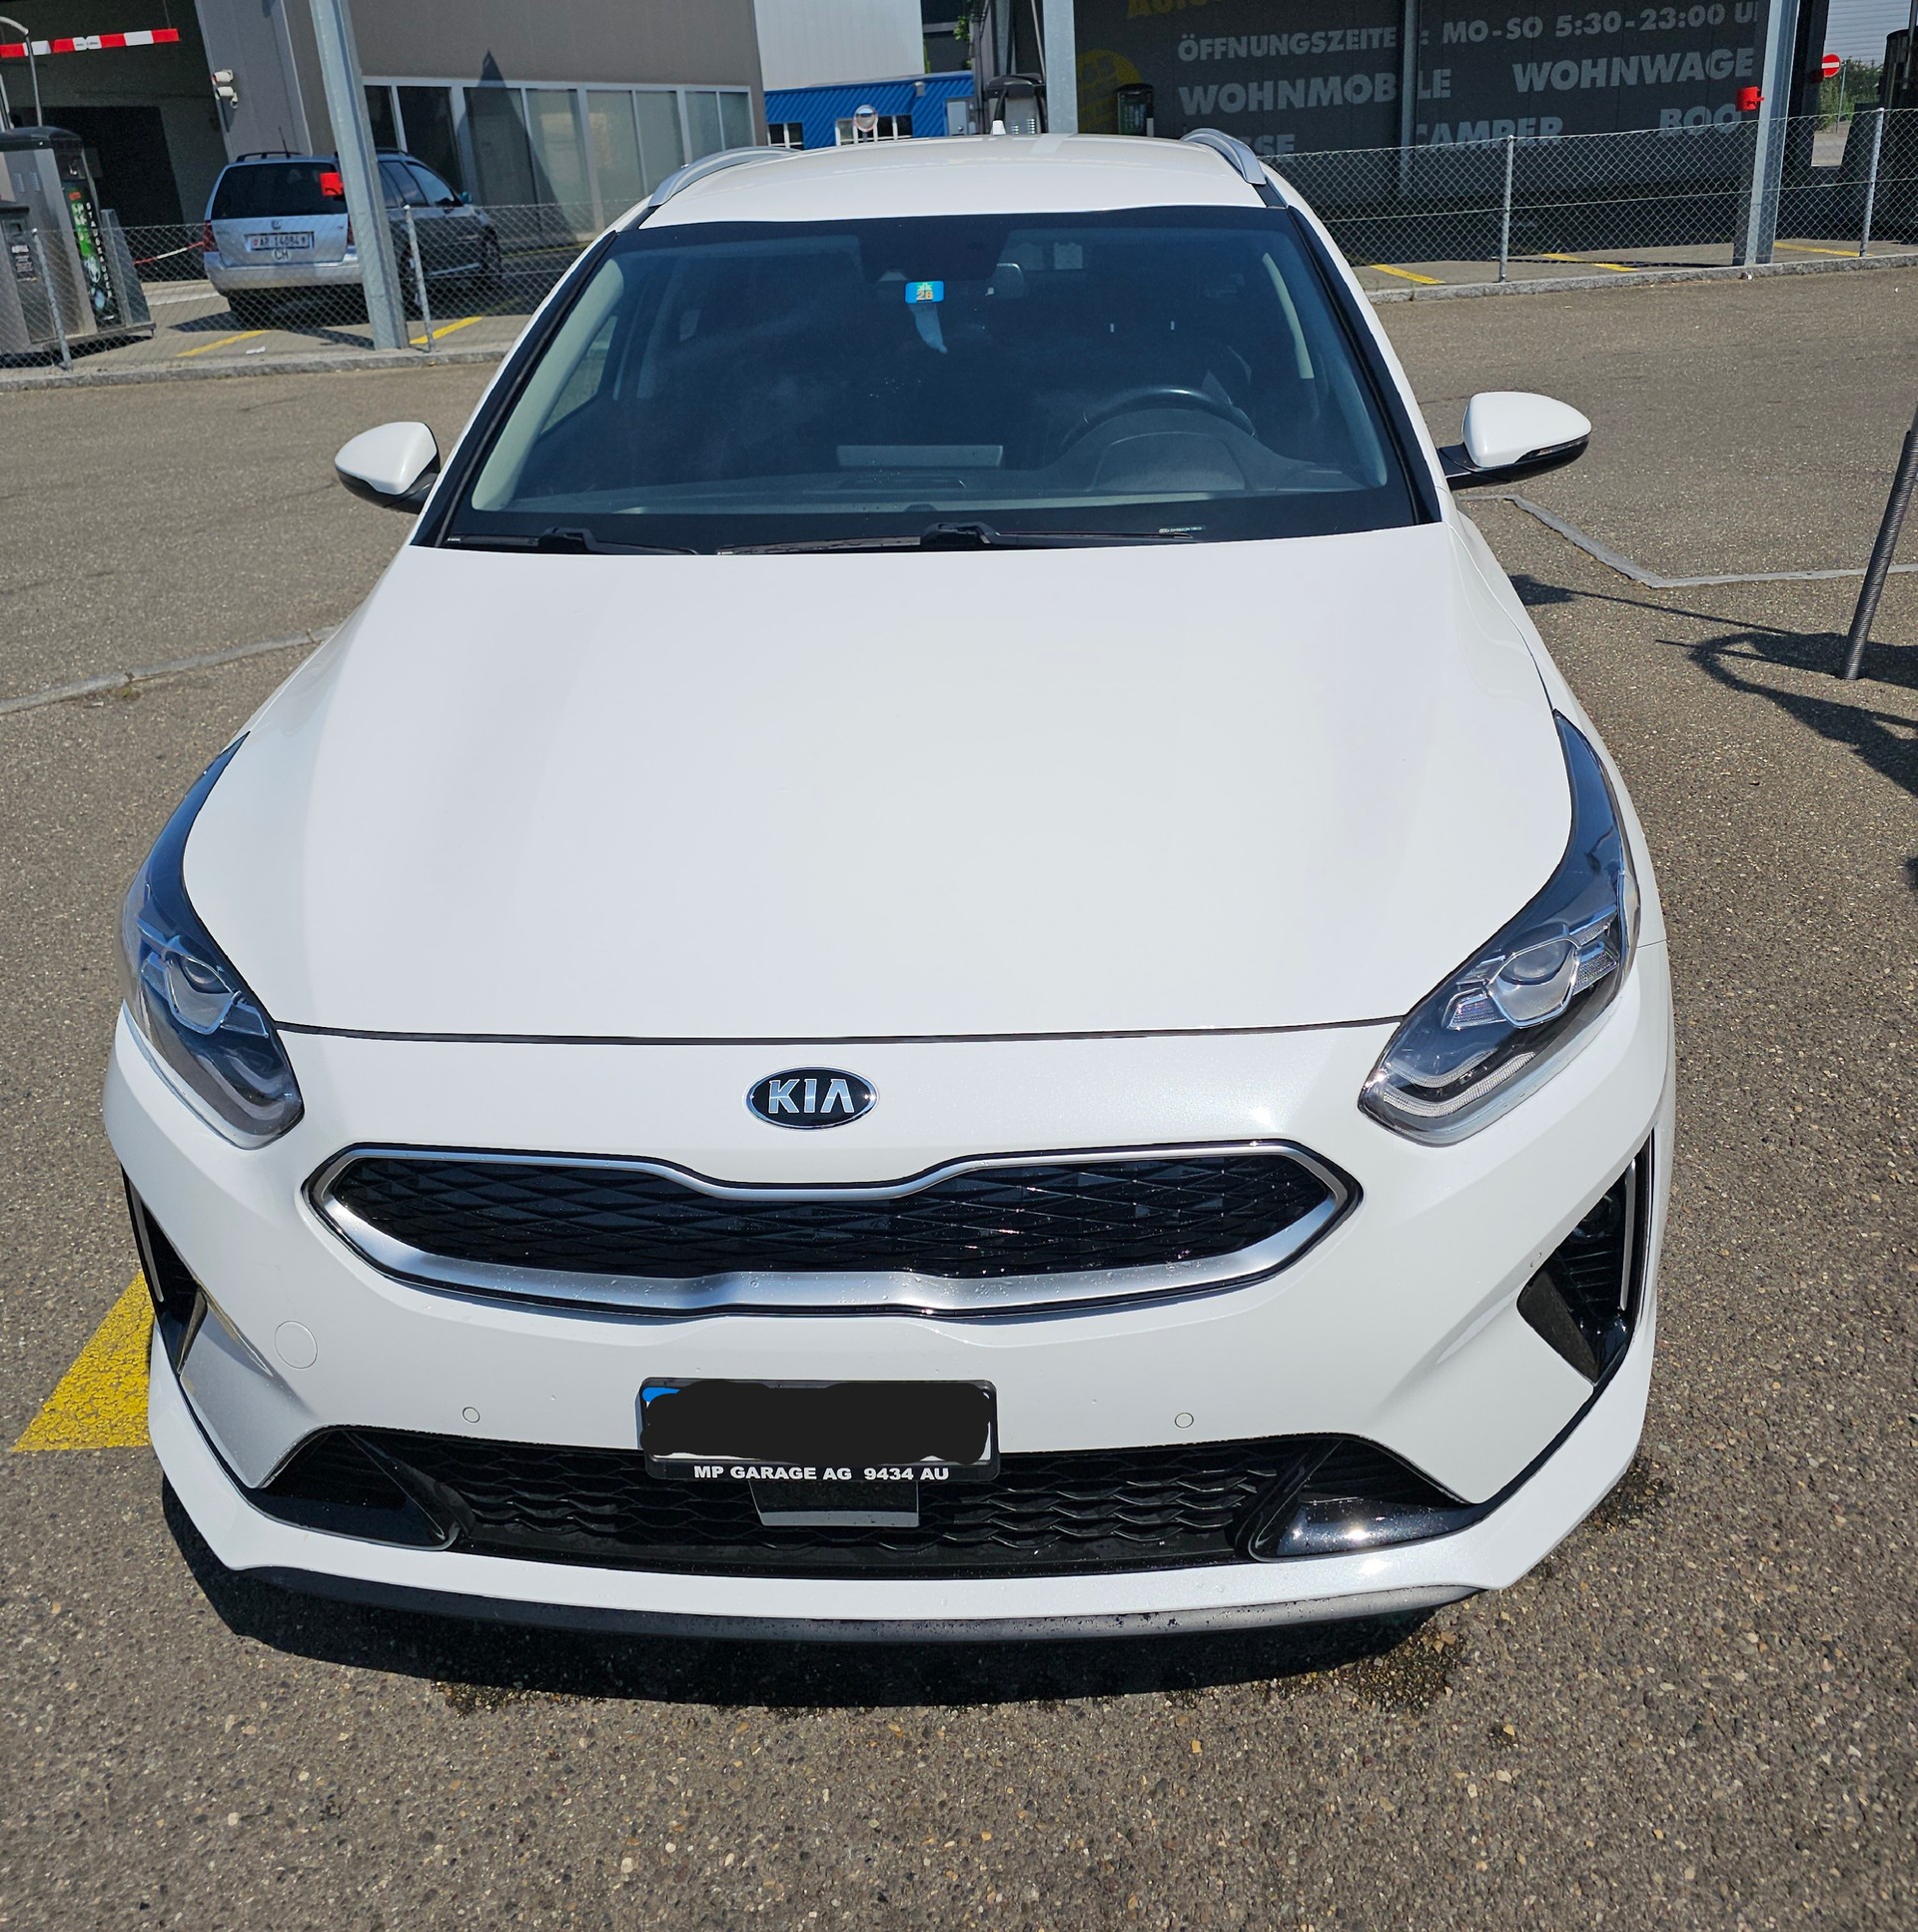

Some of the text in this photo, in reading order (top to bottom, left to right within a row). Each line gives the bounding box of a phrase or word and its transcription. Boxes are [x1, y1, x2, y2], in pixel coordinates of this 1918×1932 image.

[1178, 27, 1429, 62] ÖFFNUNGSZEITE:
[1179, 69, 1451, 116] WOHNMOBLE
[768, 1079, 855, 1114] KIA
[694, 1465, 949, 1480] MP GARAGE AG 9434 AU
